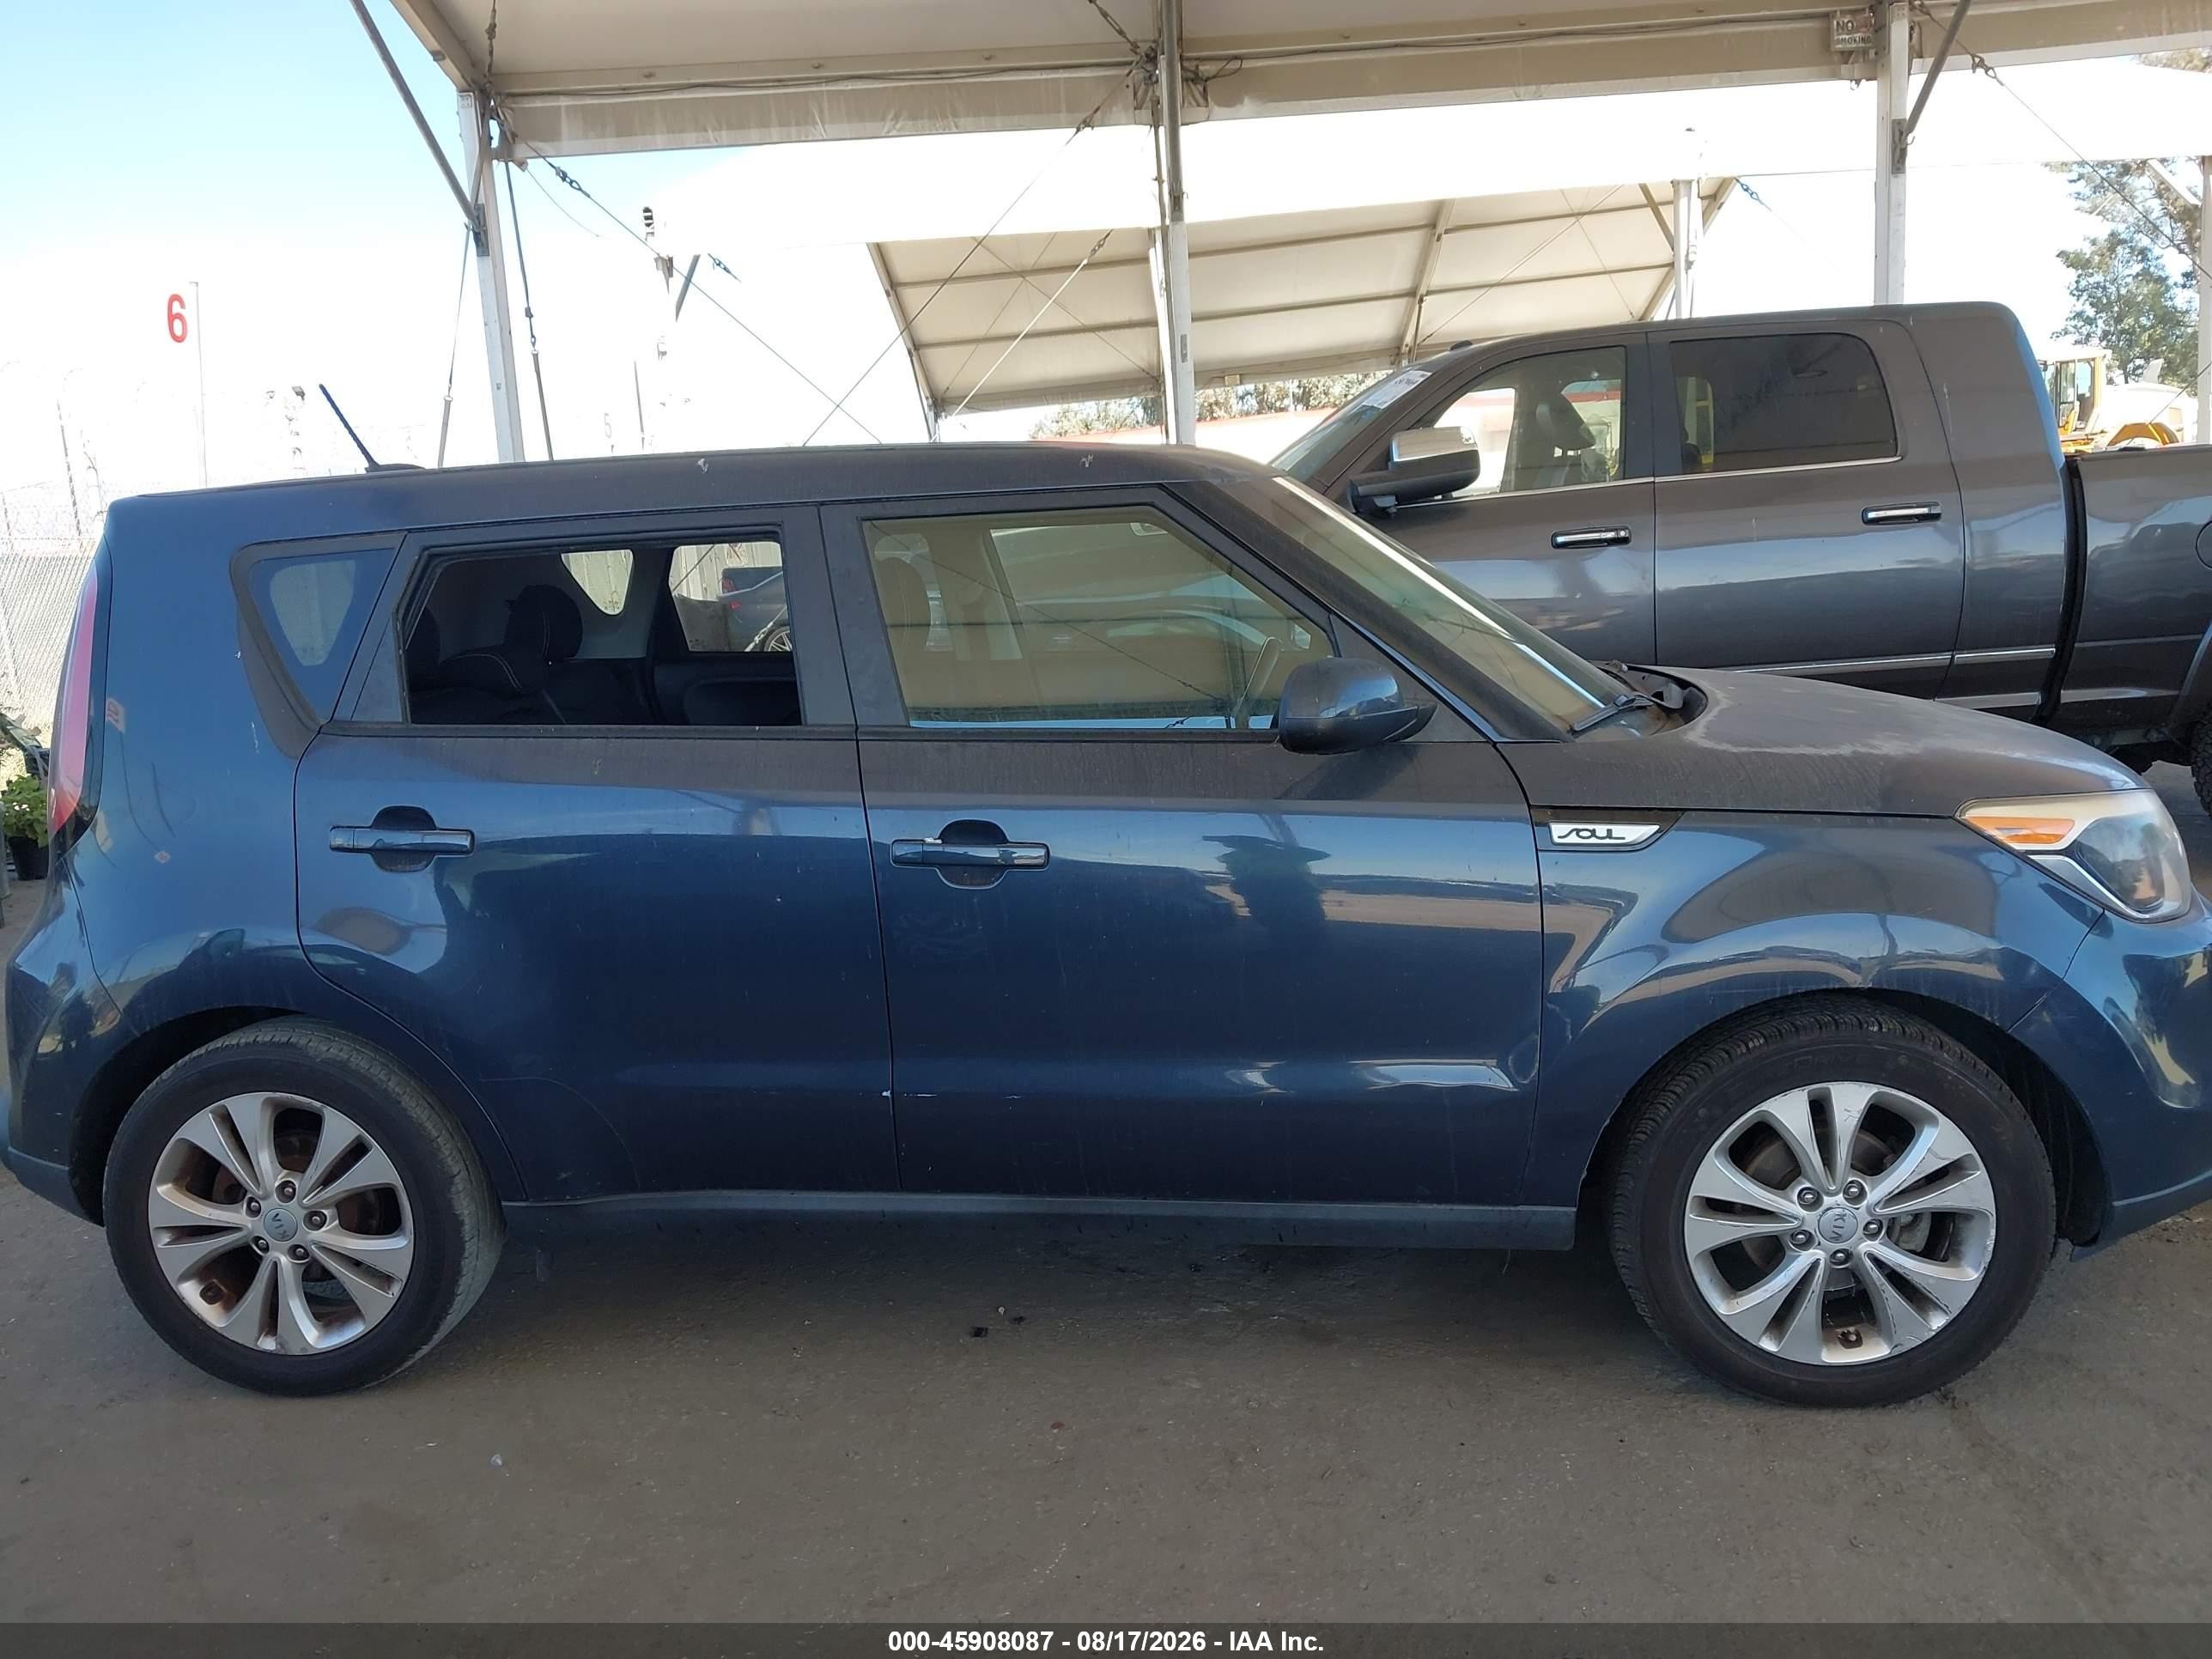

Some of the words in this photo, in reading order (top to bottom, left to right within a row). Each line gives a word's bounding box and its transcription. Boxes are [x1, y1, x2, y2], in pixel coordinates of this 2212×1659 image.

[1836, 20, 1854, 32] NO
[167, 293, 188, 343] 6
[1557, 828, 1626, 840] SOUL
[271, 1212, 290, 1239] KIA
[1830, 1212, 1848, 1240] KIA
